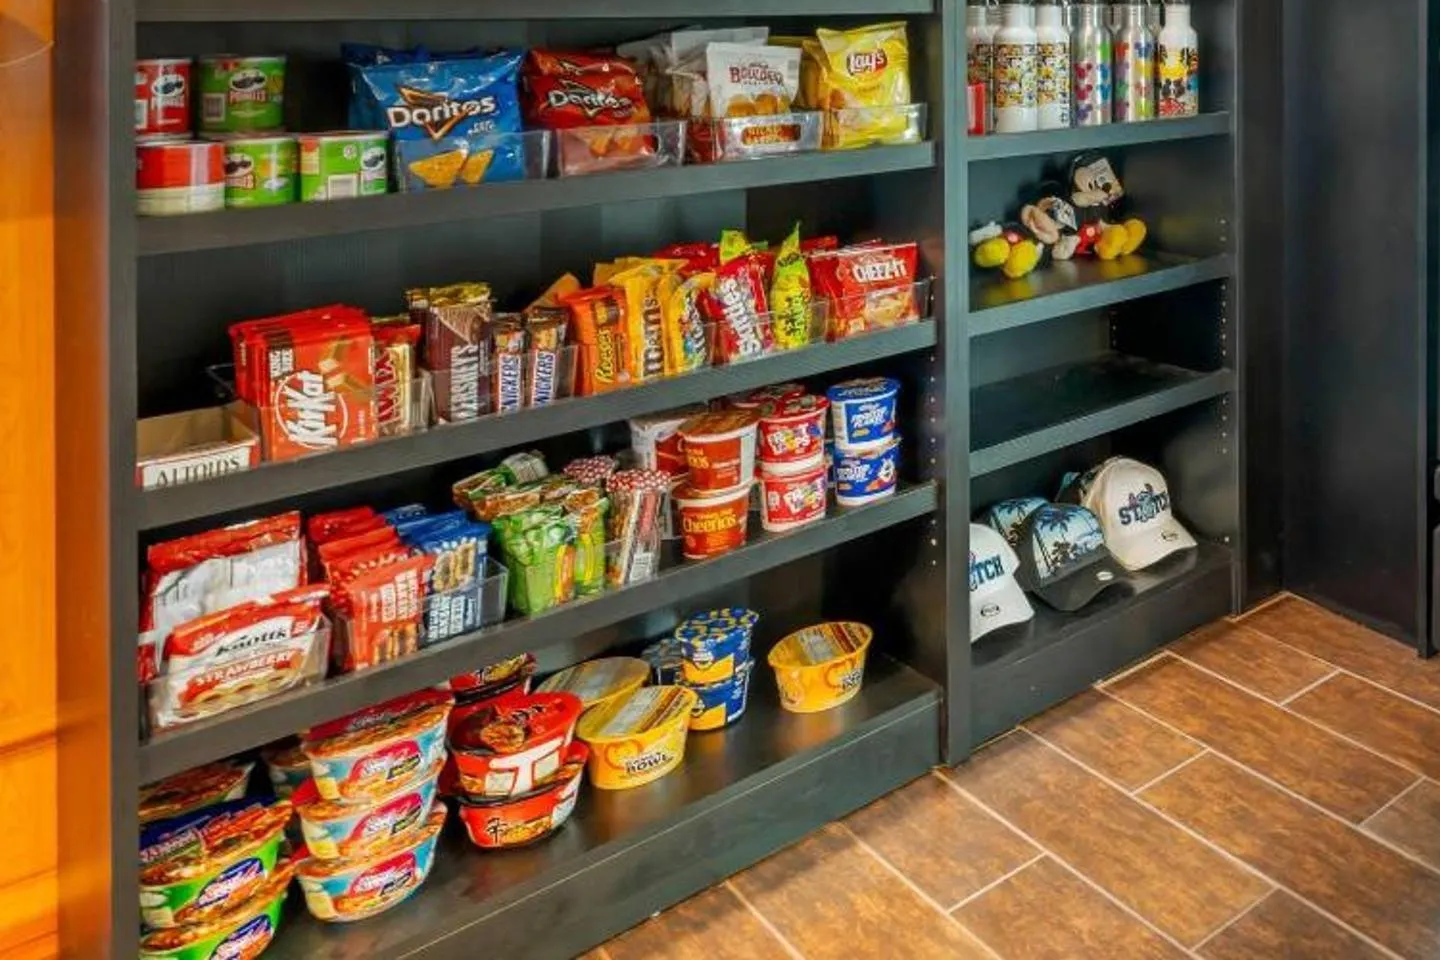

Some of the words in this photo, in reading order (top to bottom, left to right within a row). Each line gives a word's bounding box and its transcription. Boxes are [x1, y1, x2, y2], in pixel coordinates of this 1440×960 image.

[849, 48, 888, 73] Lay's
[385, 95, 497, 128] Doritos
[547, 87, 634, 111] Doritos
[851, 257, 908, 284] CHEEZ-IT
[156, 455, 241, 487] ALTOIDS
[683, 514, 737, 534] Cheerios
